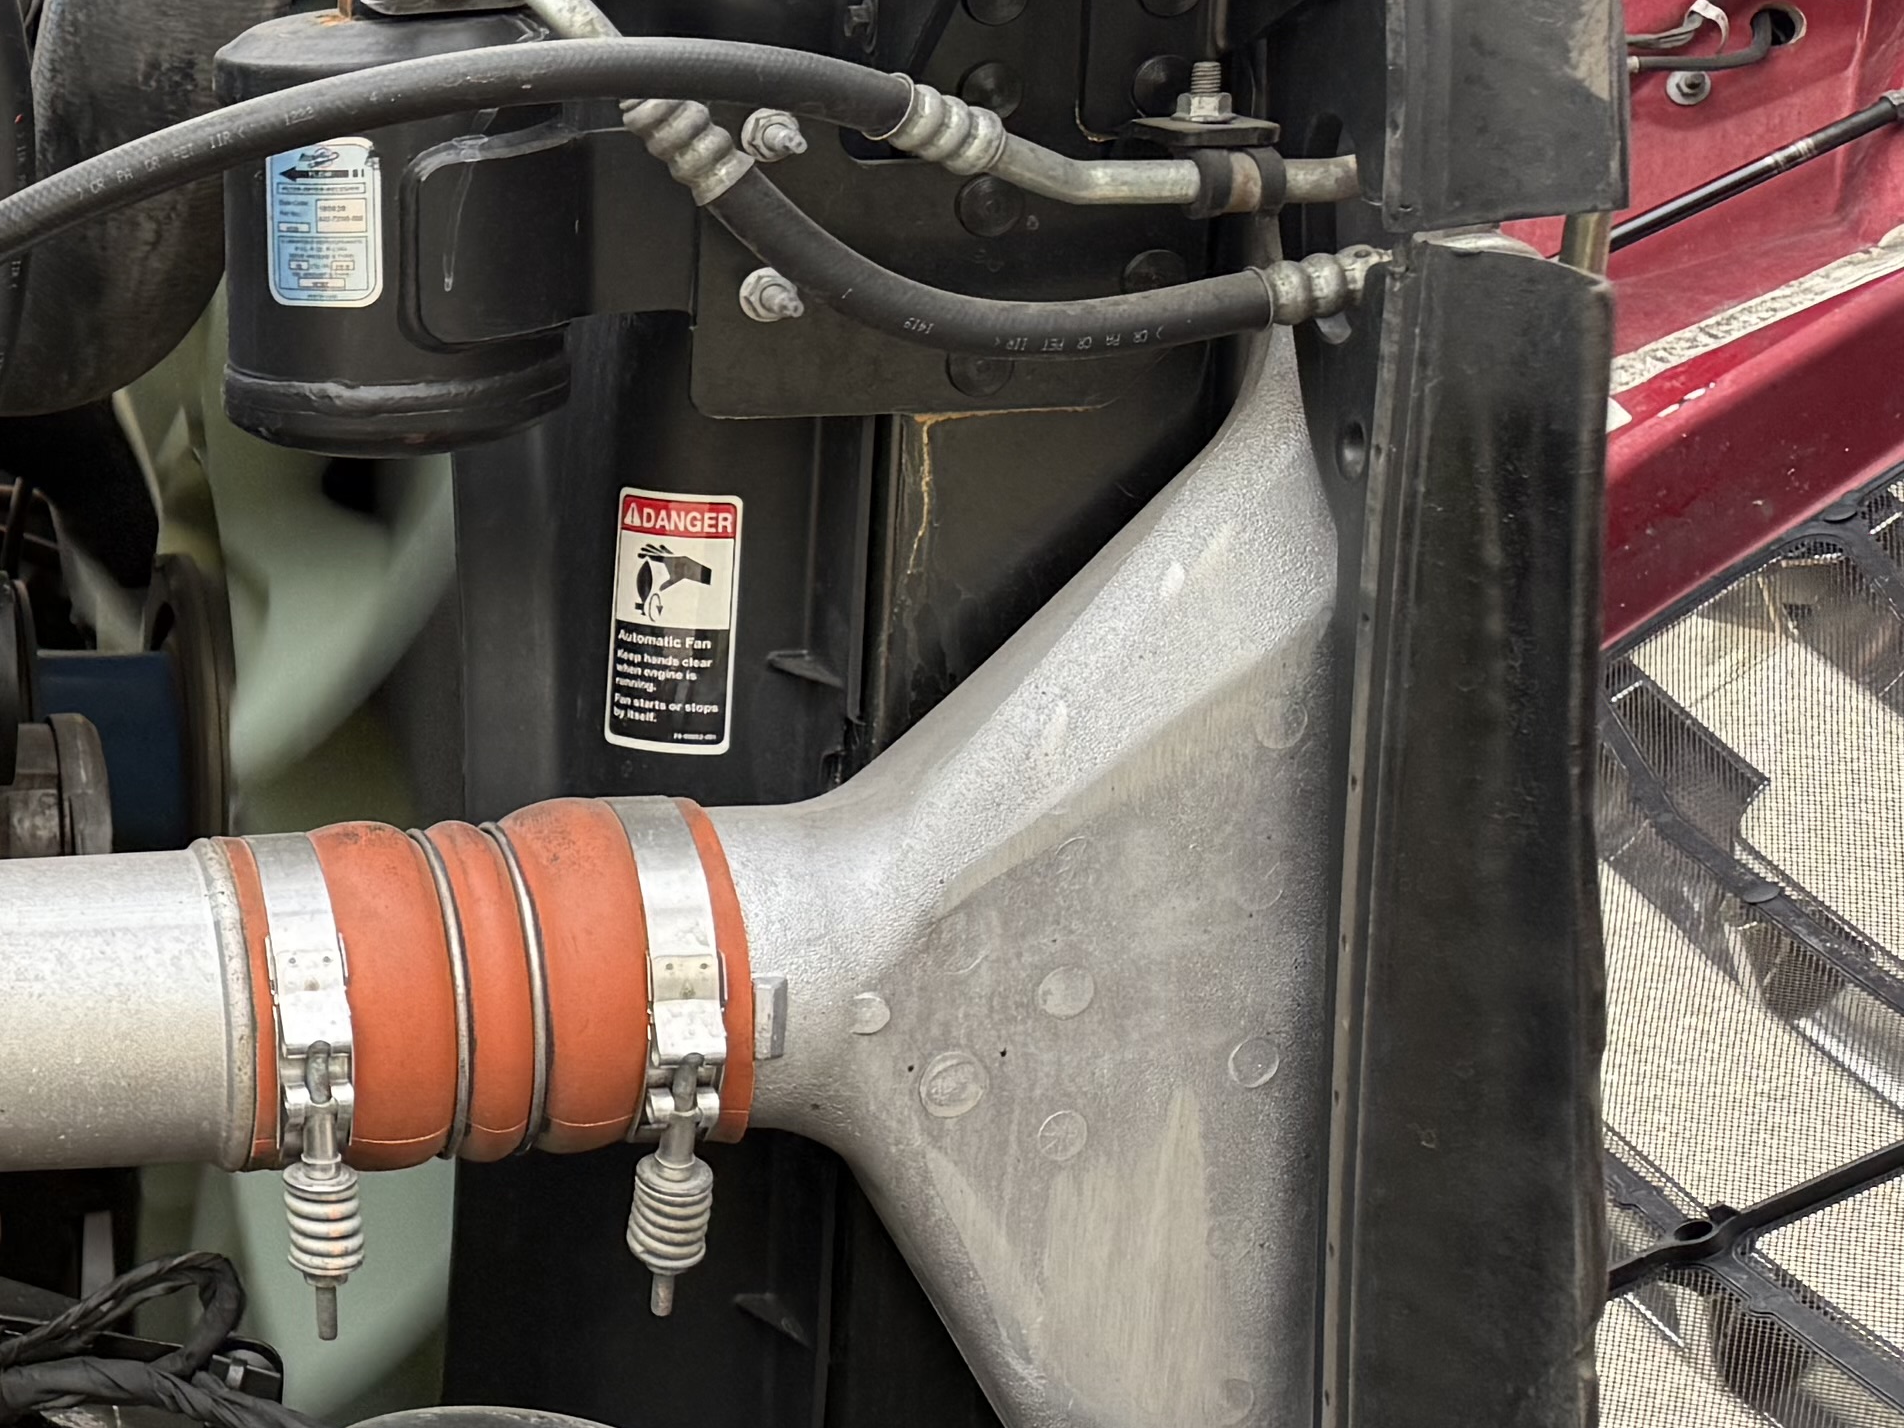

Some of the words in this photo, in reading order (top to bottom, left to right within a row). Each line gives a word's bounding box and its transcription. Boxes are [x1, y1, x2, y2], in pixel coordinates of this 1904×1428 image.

[642, 508, 733, 533] DANGER
[618, 629, 682, 649] Automatic
[685, 637, 712, 650] Fan
[617, 649, 642, 664] Keep
[644, 652, 679, 667] hands
[682, 657, 713, 668] clear
[616, 664, 641, 676] when
[644, 668, 683, 681] engine
[686, 670, 697, 681] is
[615, 677, 656, 692] running.
[614, 693, 631, 705] Fan
[633, 697, 666, 710] starts
[668, 703, 682, 712] or
[685, 703, 719, 715] stops
[613, 706, 625, 720] by
[627, 708, 657, 723] itself.
